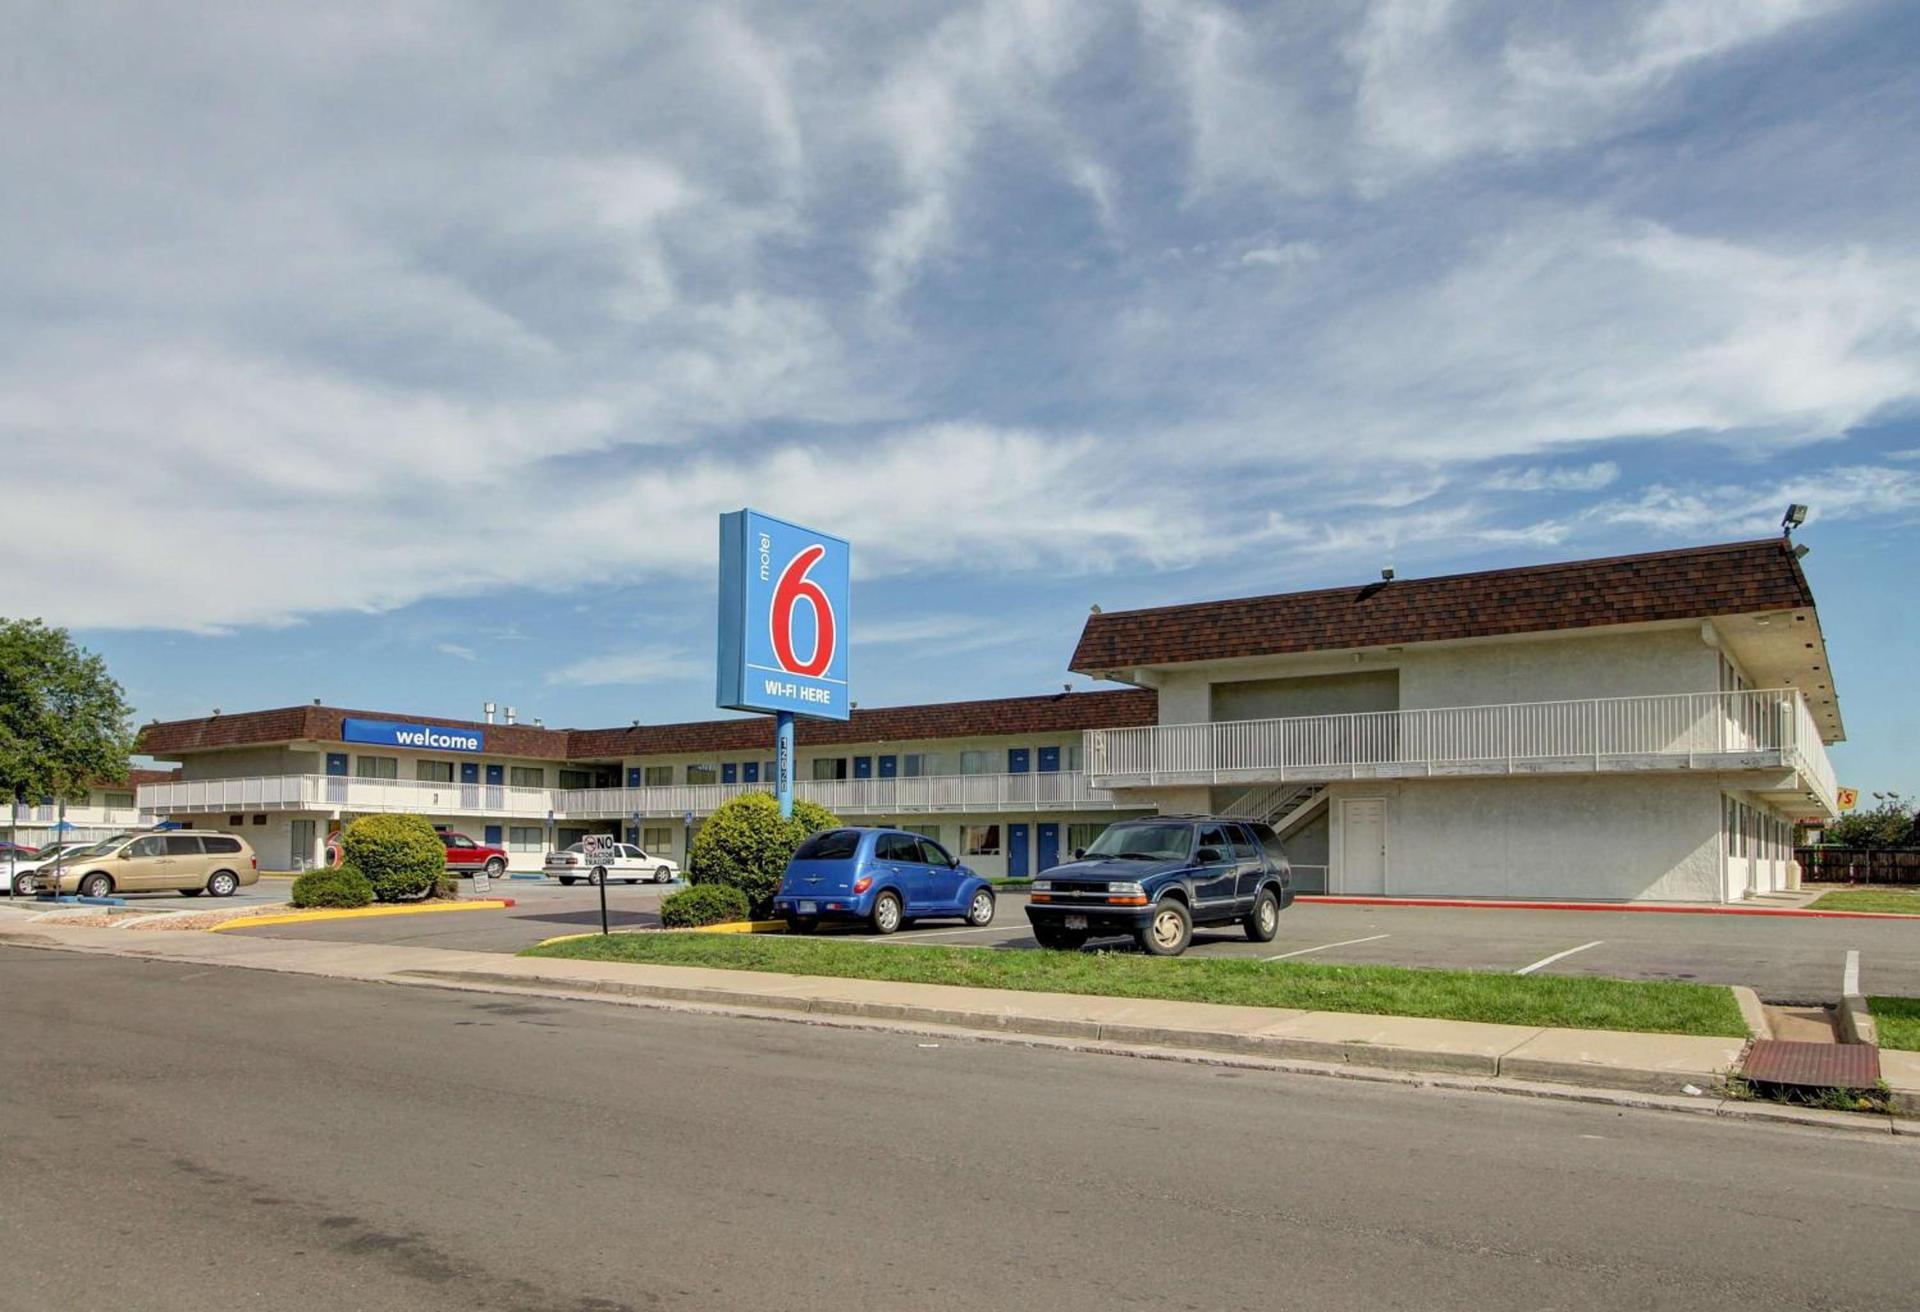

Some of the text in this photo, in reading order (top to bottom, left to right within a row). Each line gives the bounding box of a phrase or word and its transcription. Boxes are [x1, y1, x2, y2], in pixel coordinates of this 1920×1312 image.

[759, 533, 770, 581] motel
[769, 544, 836, 678] 6
[765, 679, 831, 704] WI-FI HERE
[396, 728, 478, 750] welcome
[597, 836, 613, 849] NO
